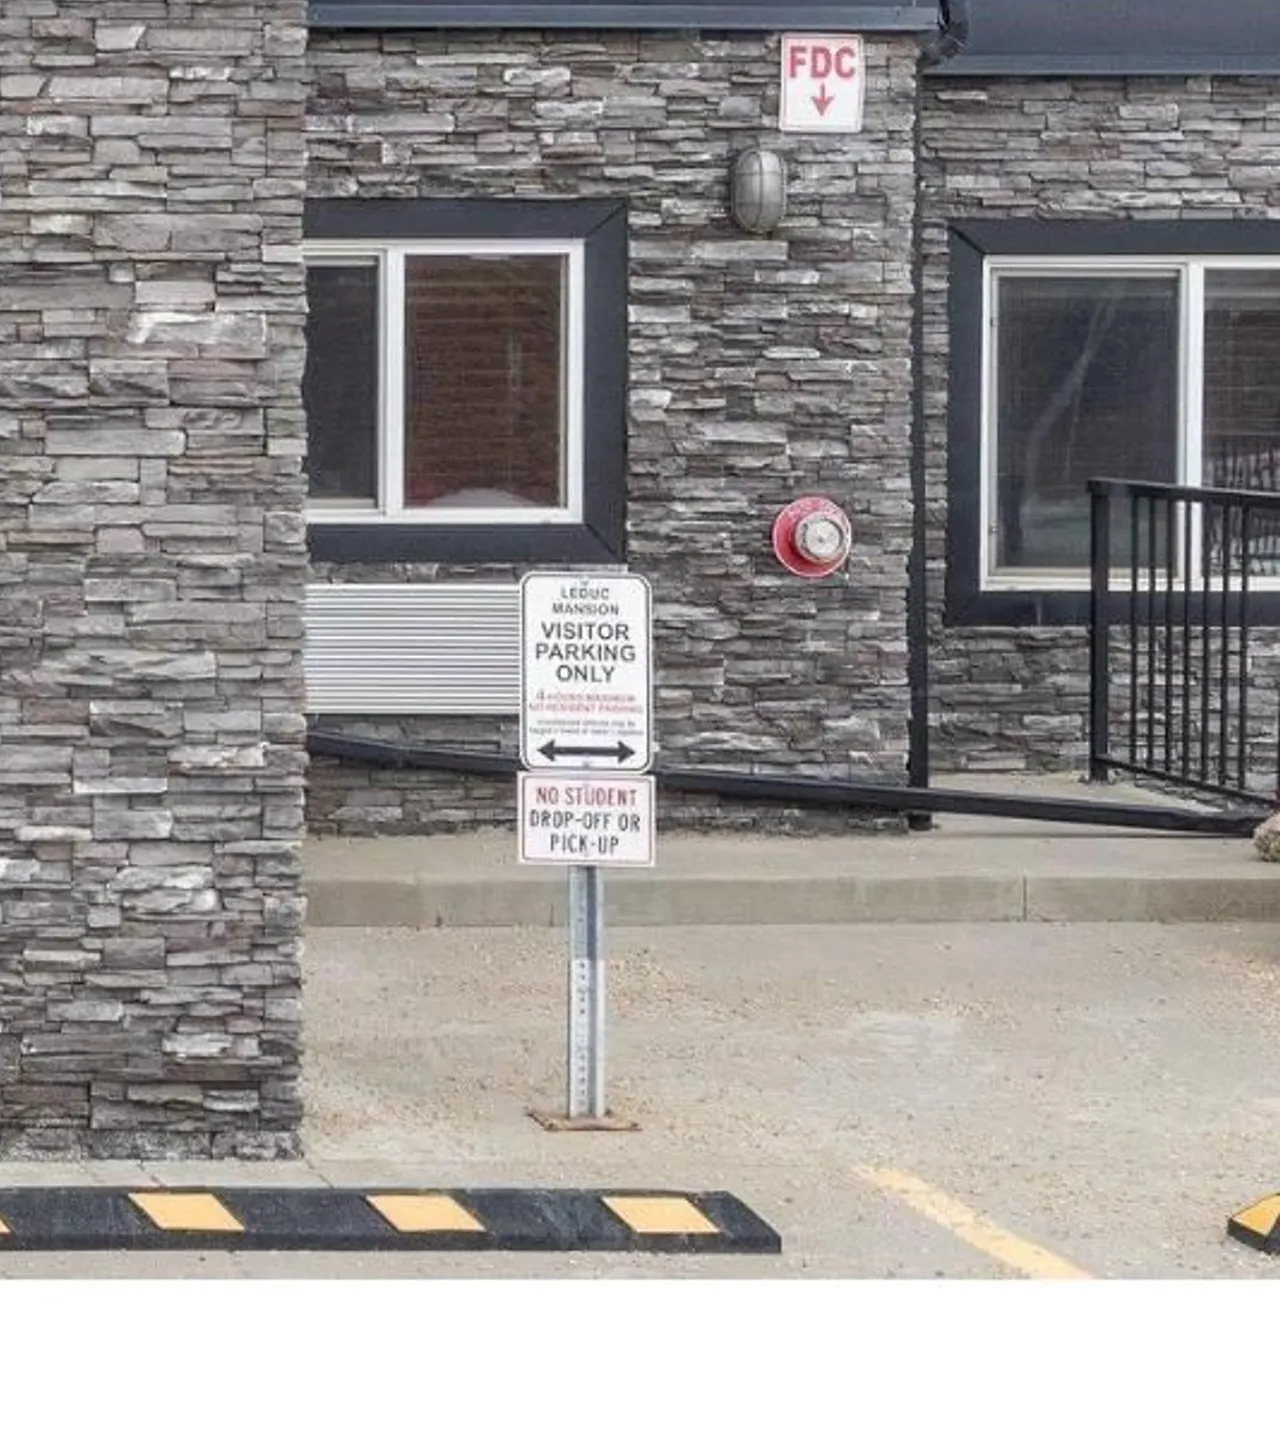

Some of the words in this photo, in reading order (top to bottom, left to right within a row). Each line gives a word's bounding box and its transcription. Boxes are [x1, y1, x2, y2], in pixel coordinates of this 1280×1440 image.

[789, 46, 856, 78] FDC
[560, 587, 610, 599] LEDUC
[552, 602, 620, 616] MANSION
[541, 621, 629, 641] VISITOR
[535, 642, 636, 662] PARKING
[556, 664, 616, 683] ONLY
[536, 787, 559, 806] NO
[565, 787, 638, 807] STUDENT
[529, 809, 611, 829] DROP-OFF
[618, 813, 641, 833] OR
[549, 833, 620, 855] PICK-UP
